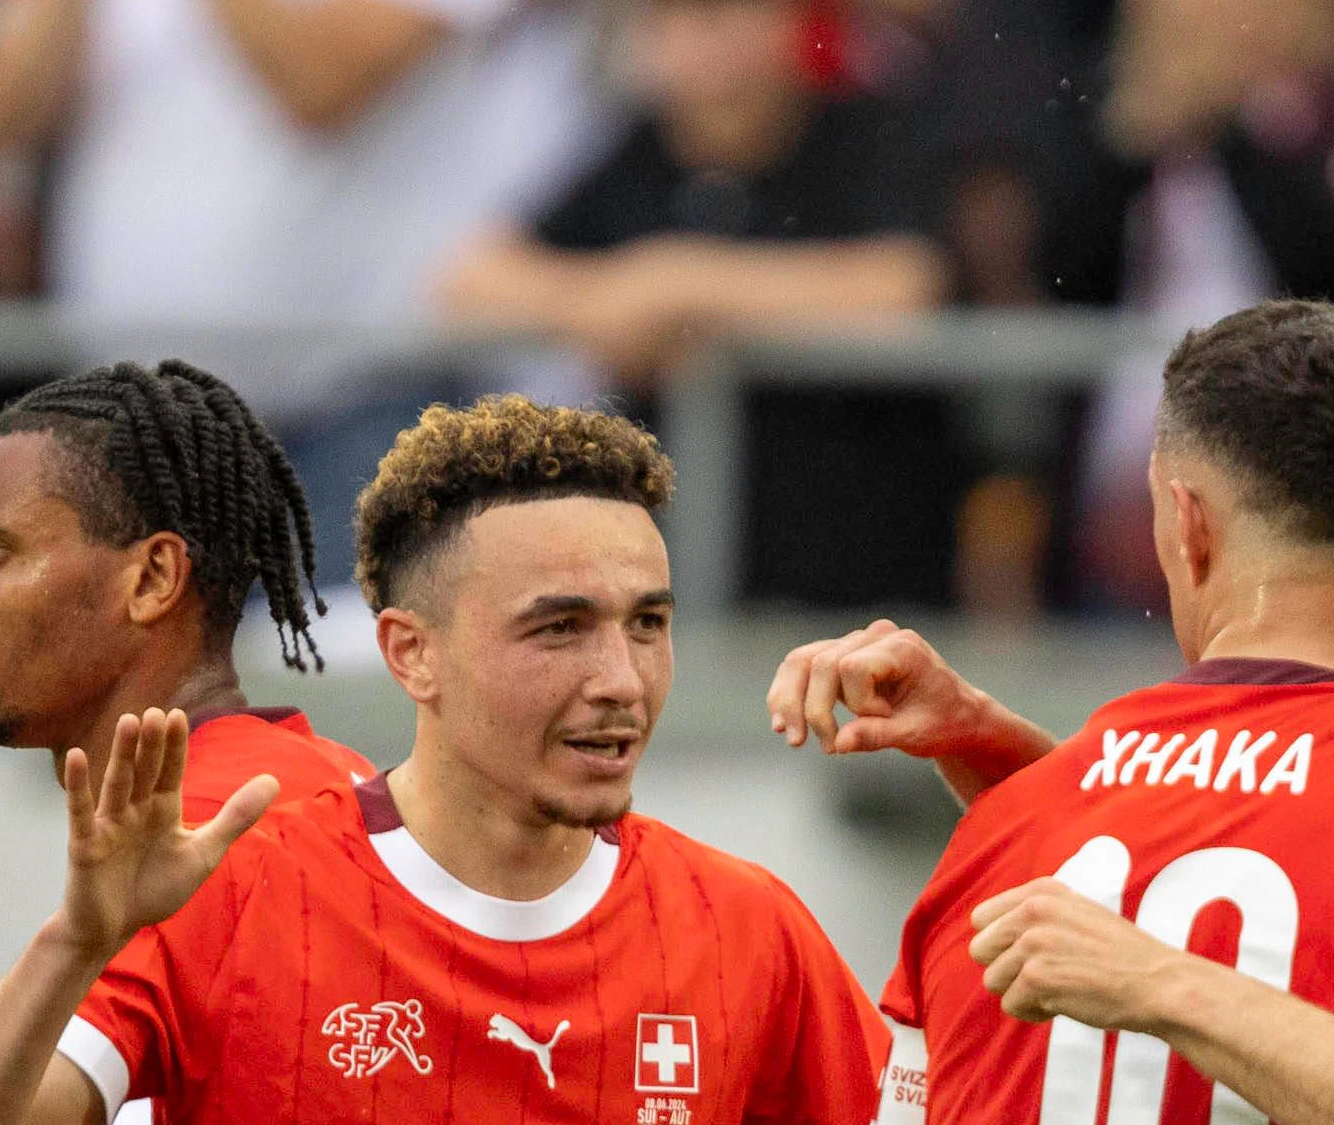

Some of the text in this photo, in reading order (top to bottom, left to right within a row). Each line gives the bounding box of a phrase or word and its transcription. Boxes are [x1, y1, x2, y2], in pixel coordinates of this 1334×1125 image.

[1080, 728, 1314, 795] XHAKA
[895, 1086, 926, 1107] SVI
[637, 1108, 657, 1125] SUI
[669, 1110, 691, 1125] AUT
